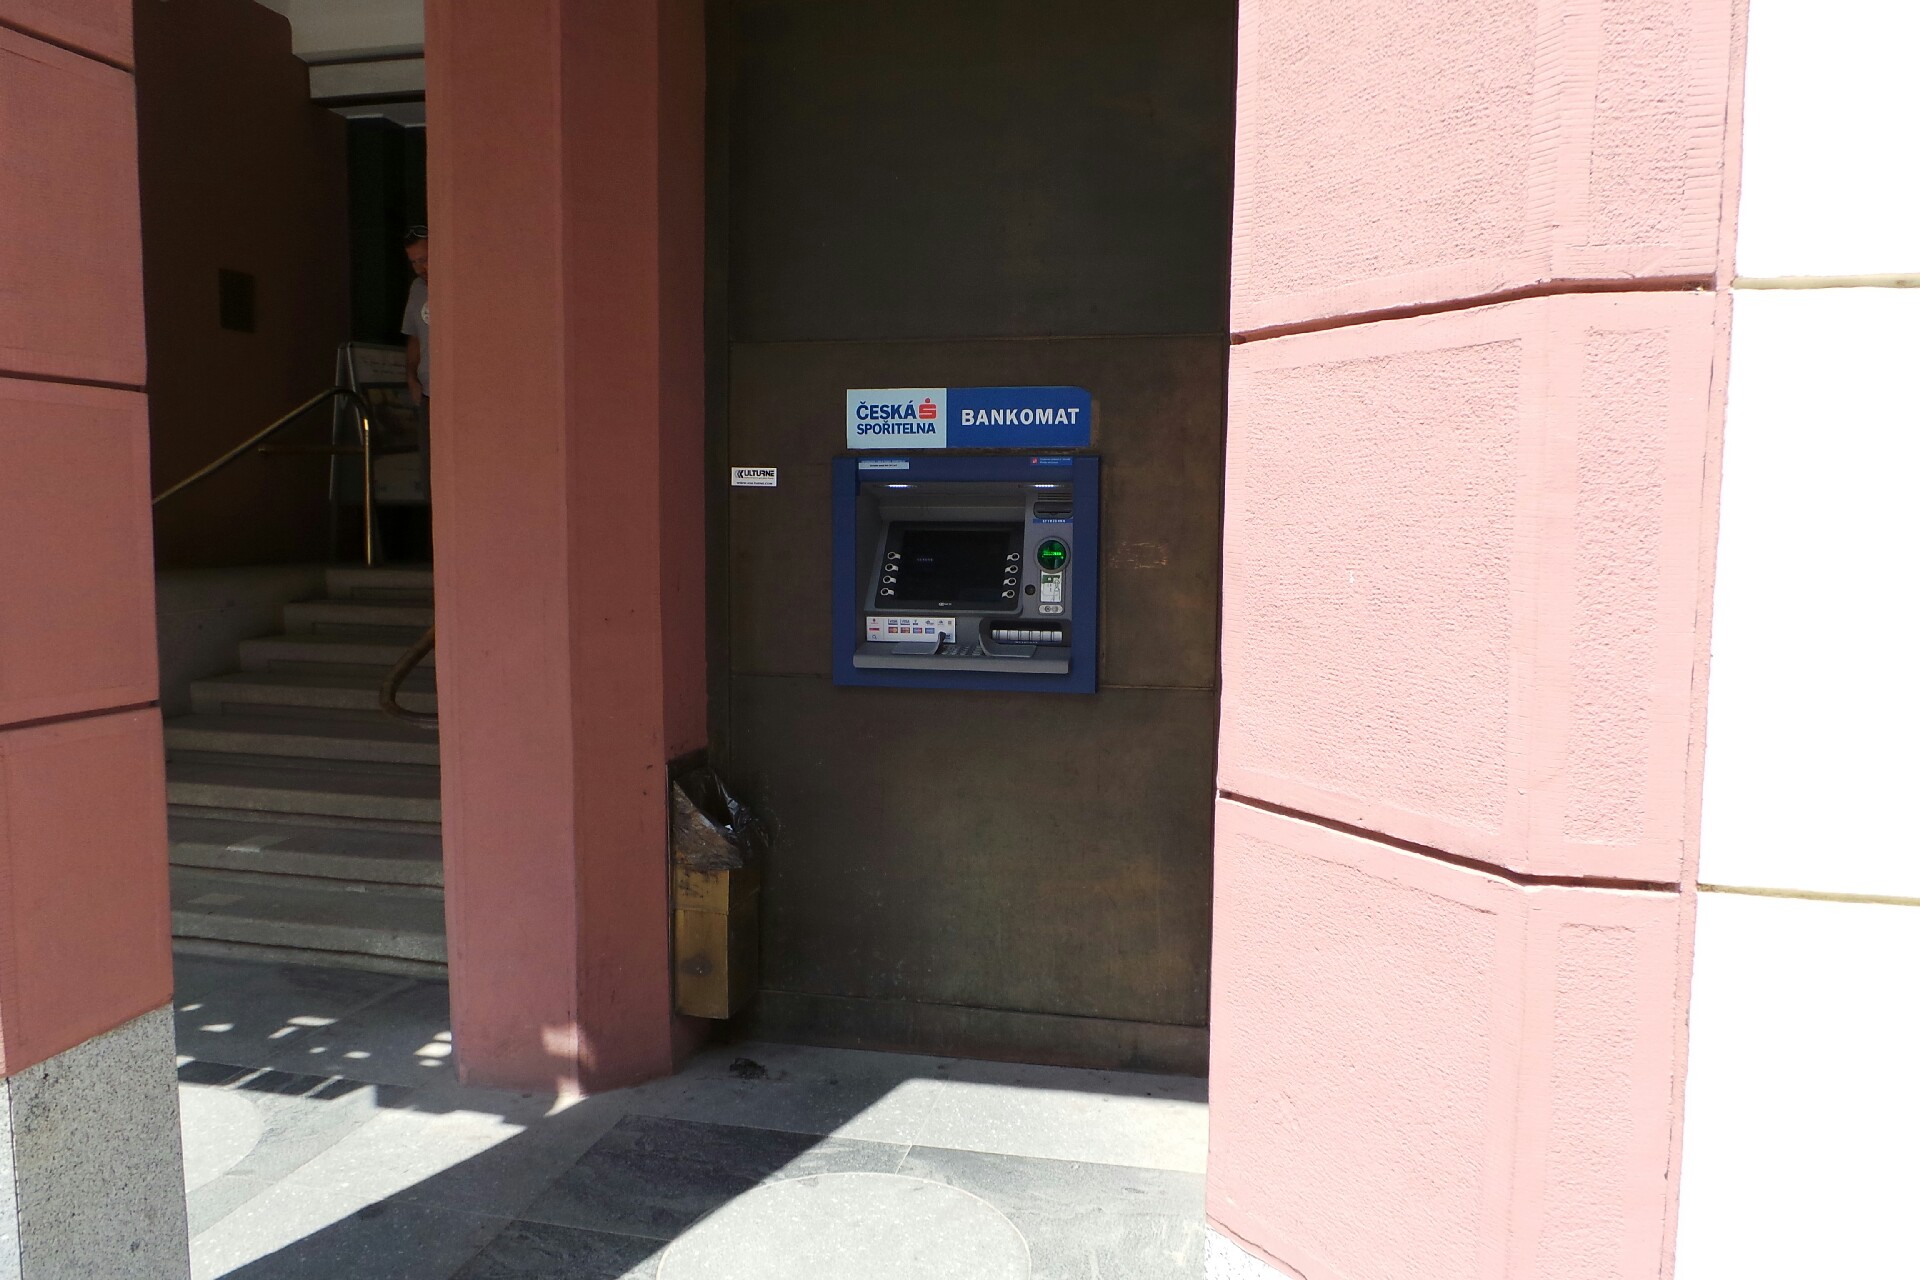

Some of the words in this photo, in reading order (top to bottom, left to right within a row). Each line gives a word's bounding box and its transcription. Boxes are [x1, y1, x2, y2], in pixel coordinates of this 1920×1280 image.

[856, 400, 917, 420] ČESKÁ
[961, 407, 1080, 426] BANKOMAT
[856, 420, 936, 435] SPOŘITELNA
